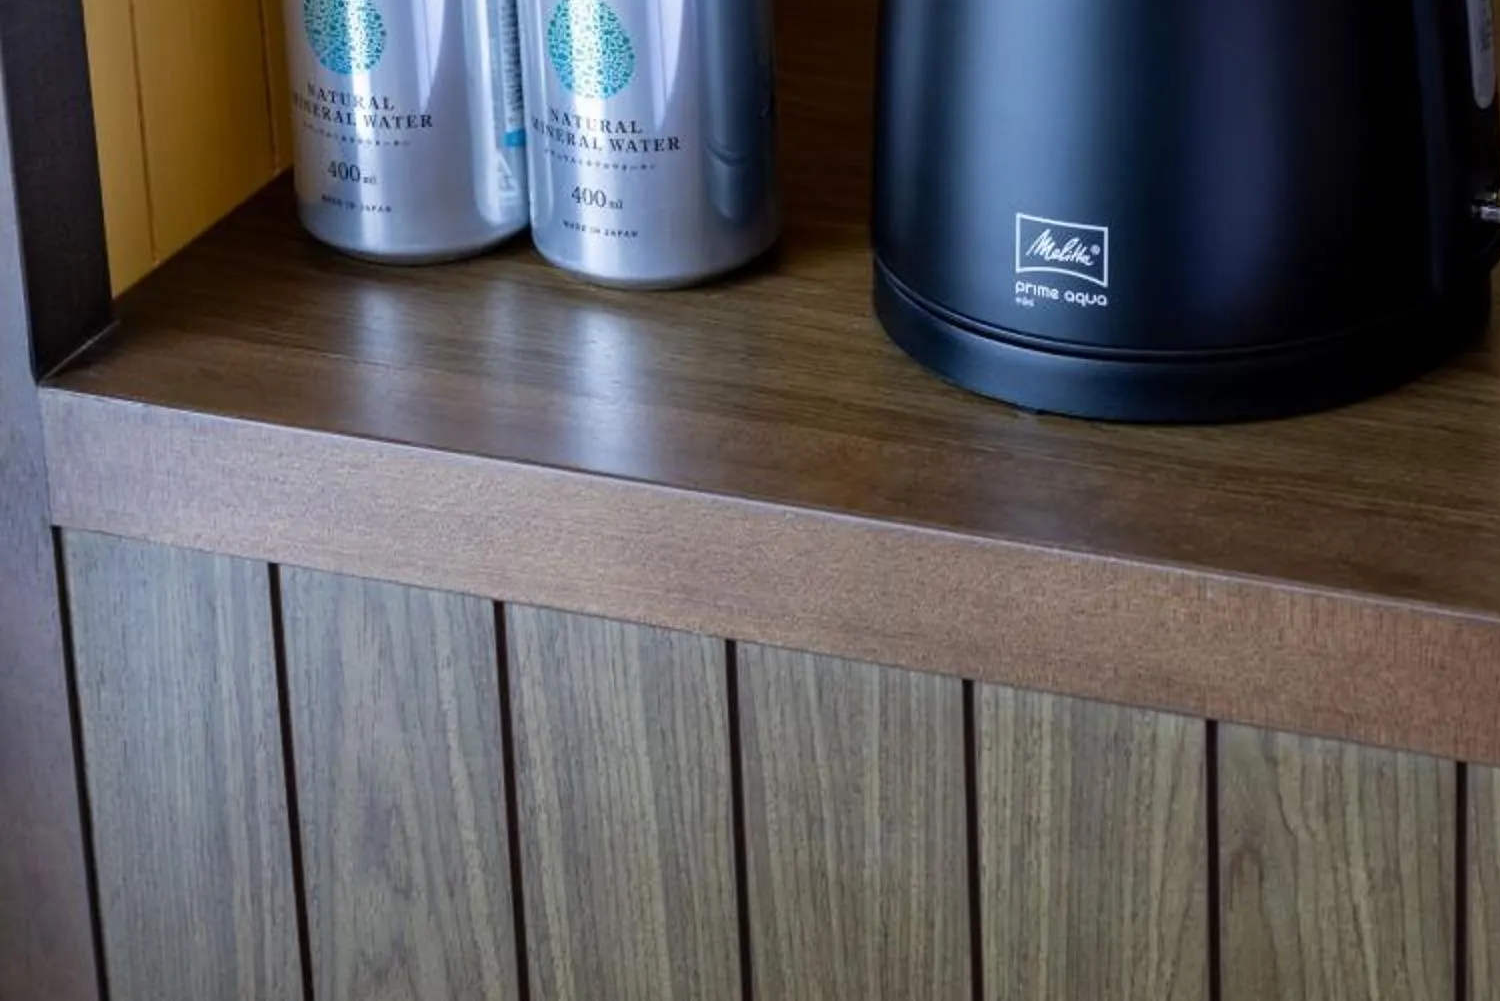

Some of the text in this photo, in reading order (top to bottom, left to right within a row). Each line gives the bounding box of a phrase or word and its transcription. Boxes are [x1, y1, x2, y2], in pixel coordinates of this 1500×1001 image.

[293, 91, 433, 130] MINERAL WATER
[306, 80, 395, 112] NATURAL
[532, 116, 681, 153] MINERAL WATER
[549, 106, 643, 134] NATURAL
[1015, 280, 1108, 307] prime aqua
